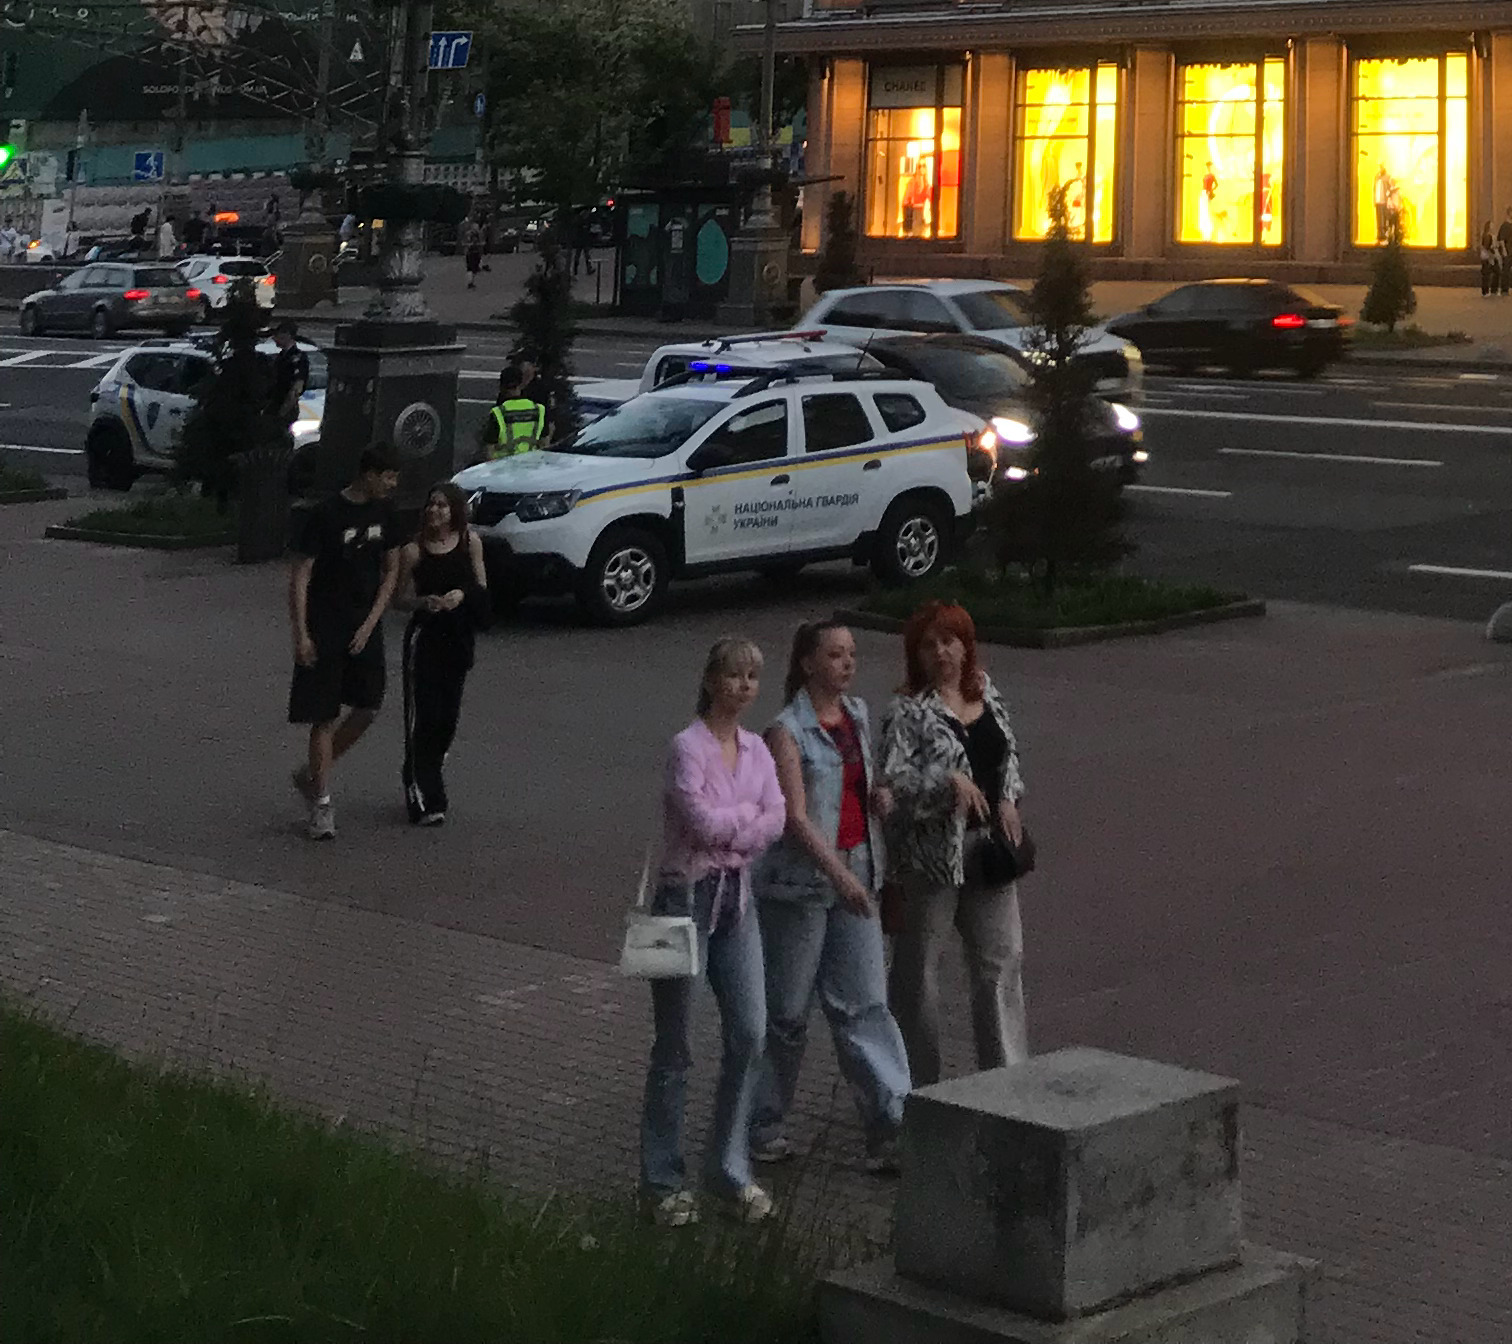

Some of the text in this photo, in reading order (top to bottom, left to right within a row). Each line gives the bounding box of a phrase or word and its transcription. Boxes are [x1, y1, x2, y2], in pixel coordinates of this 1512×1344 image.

[734, 493, 860, 514] НАЦІОНАЛЬНА ГВАРДІЯ
[733, 514, 779, 530] УКРАЇНИ
